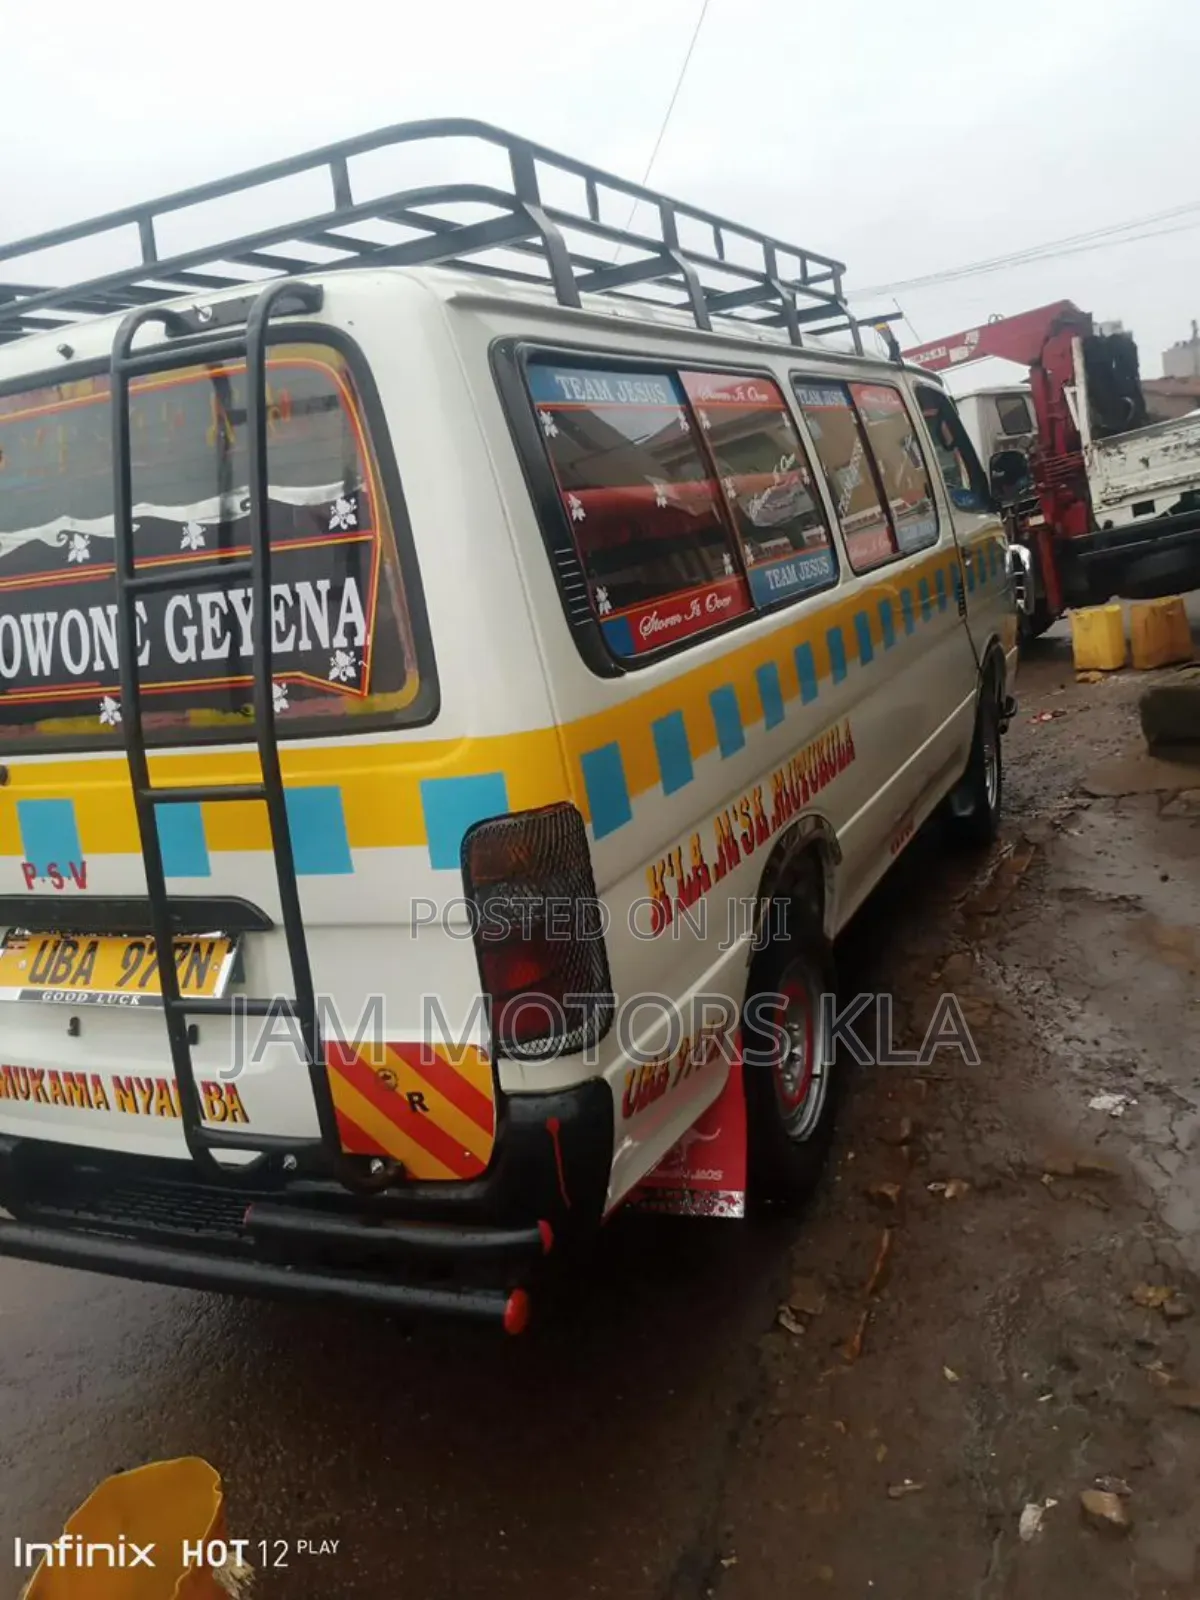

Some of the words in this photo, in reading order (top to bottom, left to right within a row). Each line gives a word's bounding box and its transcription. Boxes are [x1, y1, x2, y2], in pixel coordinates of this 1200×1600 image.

[555, 375, 613, 401] TEAM
[616, 381, 667, 404] JESUS
[765, 564, 799, 591] TEAM
[798, 555, 829, 583] JESUS
[164, 576, 367, 665] GEYENA
[639, 609, 683, 640] Storm
[705, 592, 732, 613] Over
[28, 939, 100, 986] UBA
[42, 990, 91, 1004] GOOD
[96, 993, 141, 1006] LUCK
[406, 1091, 429, 1113] R
